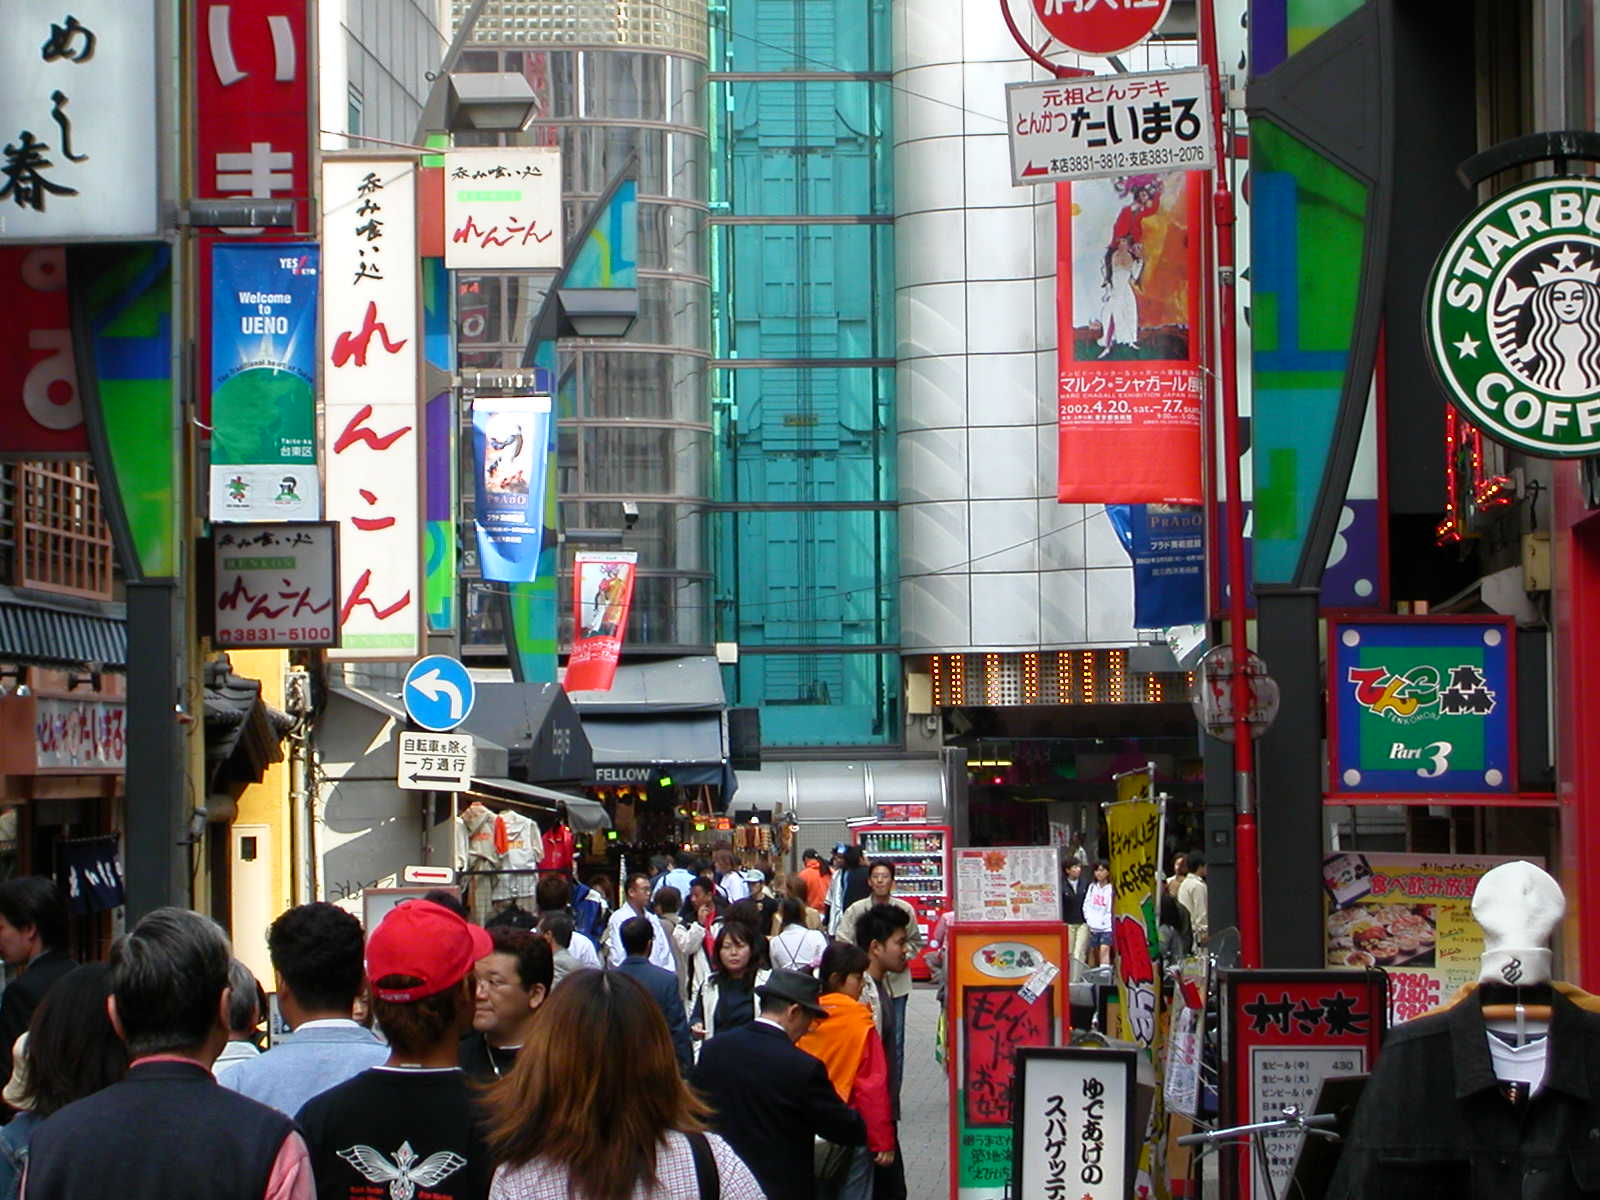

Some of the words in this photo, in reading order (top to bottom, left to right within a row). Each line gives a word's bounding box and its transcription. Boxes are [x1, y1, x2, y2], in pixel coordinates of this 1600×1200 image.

[1041, 79, 1171, 107] 元祖とんテキ
[1016, 110, 1069, 136] とんかつ
[1070, 97, 1201, 149] たいまる
[453, 215, 553, 249] れんこん
[239, 291, 292, 304] Welcome
[258, 304, 271, 315] to
[241, 316, 289, 335] UENO
[1060, 375, 1202, 393] マルク・シャガール展
[280, 446, 314, 458] 台東区
[331, 300, 411, 626] れんこん
[404, 738, 468, 754] 自転車を除く
[404, 757, 466, 773] 一方通行
[1389, 742, 1423, 760] Part
[1416, 741, 1453, 778] 3
[595, 767, 651, 783] FELLOW
[1080, 1077, 1104, 1186] ゆであげの
[1044, 1095, 1068, 1200] スパゲッテ
